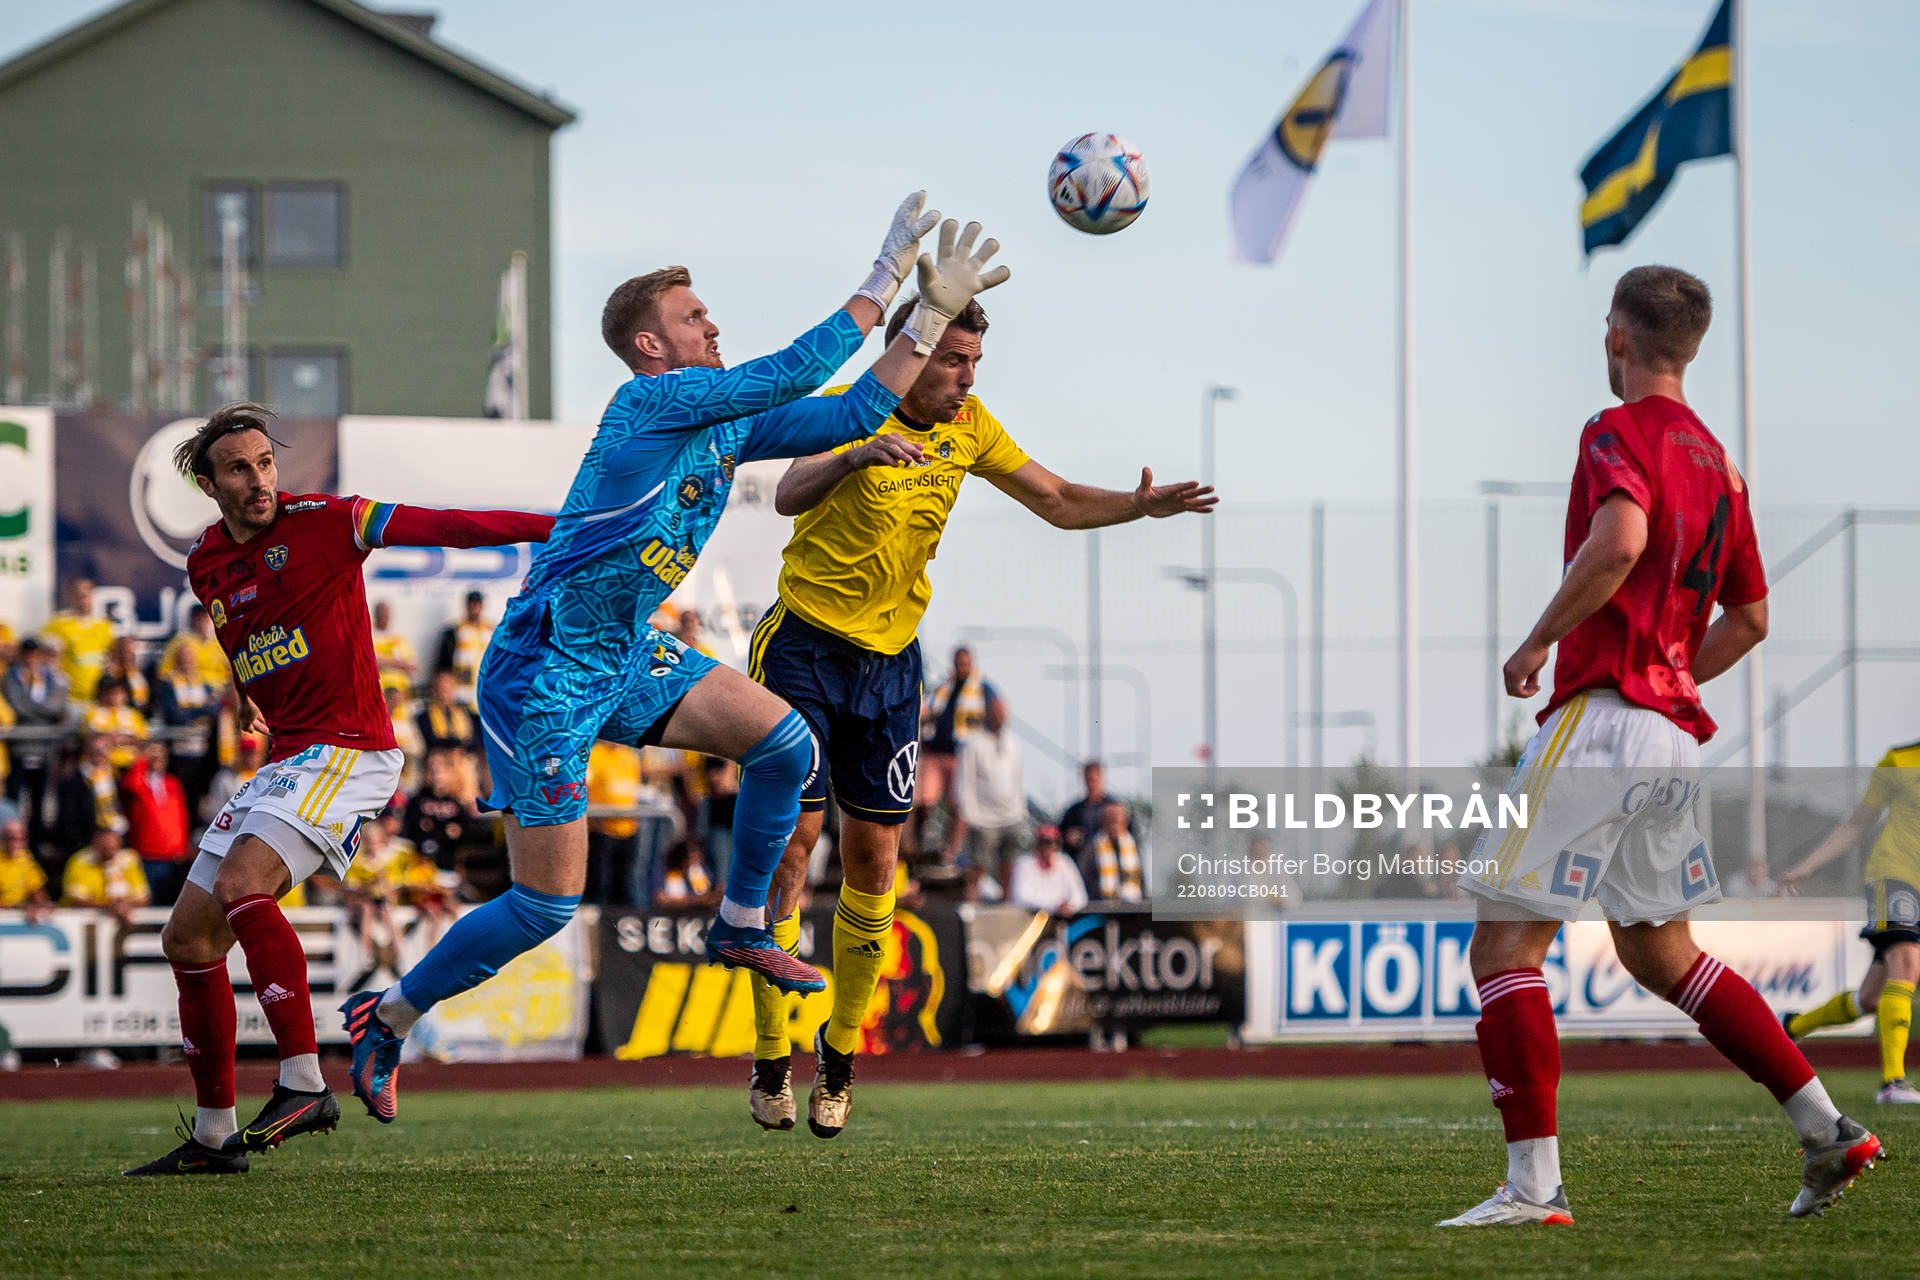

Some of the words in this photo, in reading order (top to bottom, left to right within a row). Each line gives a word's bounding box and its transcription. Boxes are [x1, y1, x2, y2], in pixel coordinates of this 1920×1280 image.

[1681, 494, 1729, 616] 4
[233, 627, 309, 684] Ullared
[248, 625, 288, 653] Gekås
